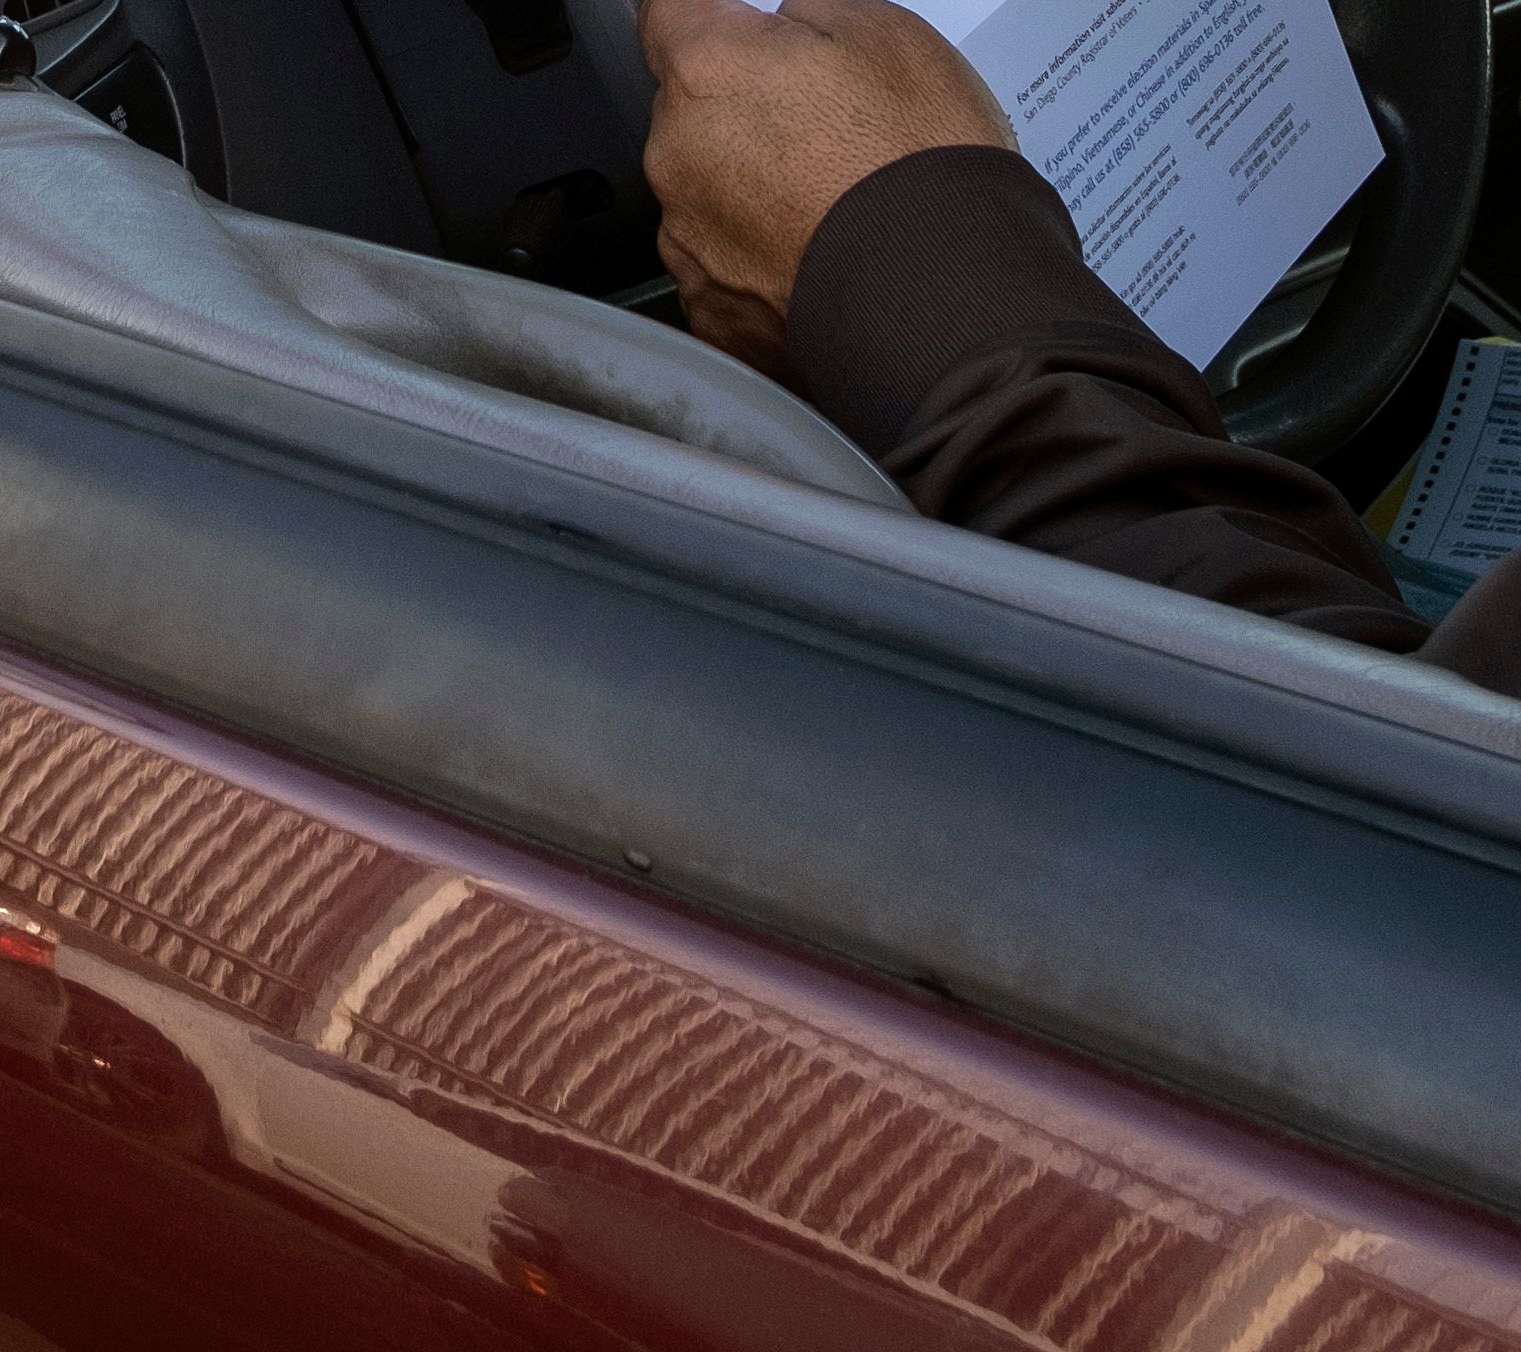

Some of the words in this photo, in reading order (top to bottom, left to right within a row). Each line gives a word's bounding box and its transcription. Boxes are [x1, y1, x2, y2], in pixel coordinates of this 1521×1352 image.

[1043, 157, 1053, 175] If
[1050, 146, 1068, 171] you
[1066, 123, 1091, 155] prefer
[1089, 112, 1100, 126] to
[1099, 84, 1128, 116] receive
[1127, 53, 1157, 89] election
[1157, 17, 1192, 56] materials
[1189, 9, 1201, 23] in
